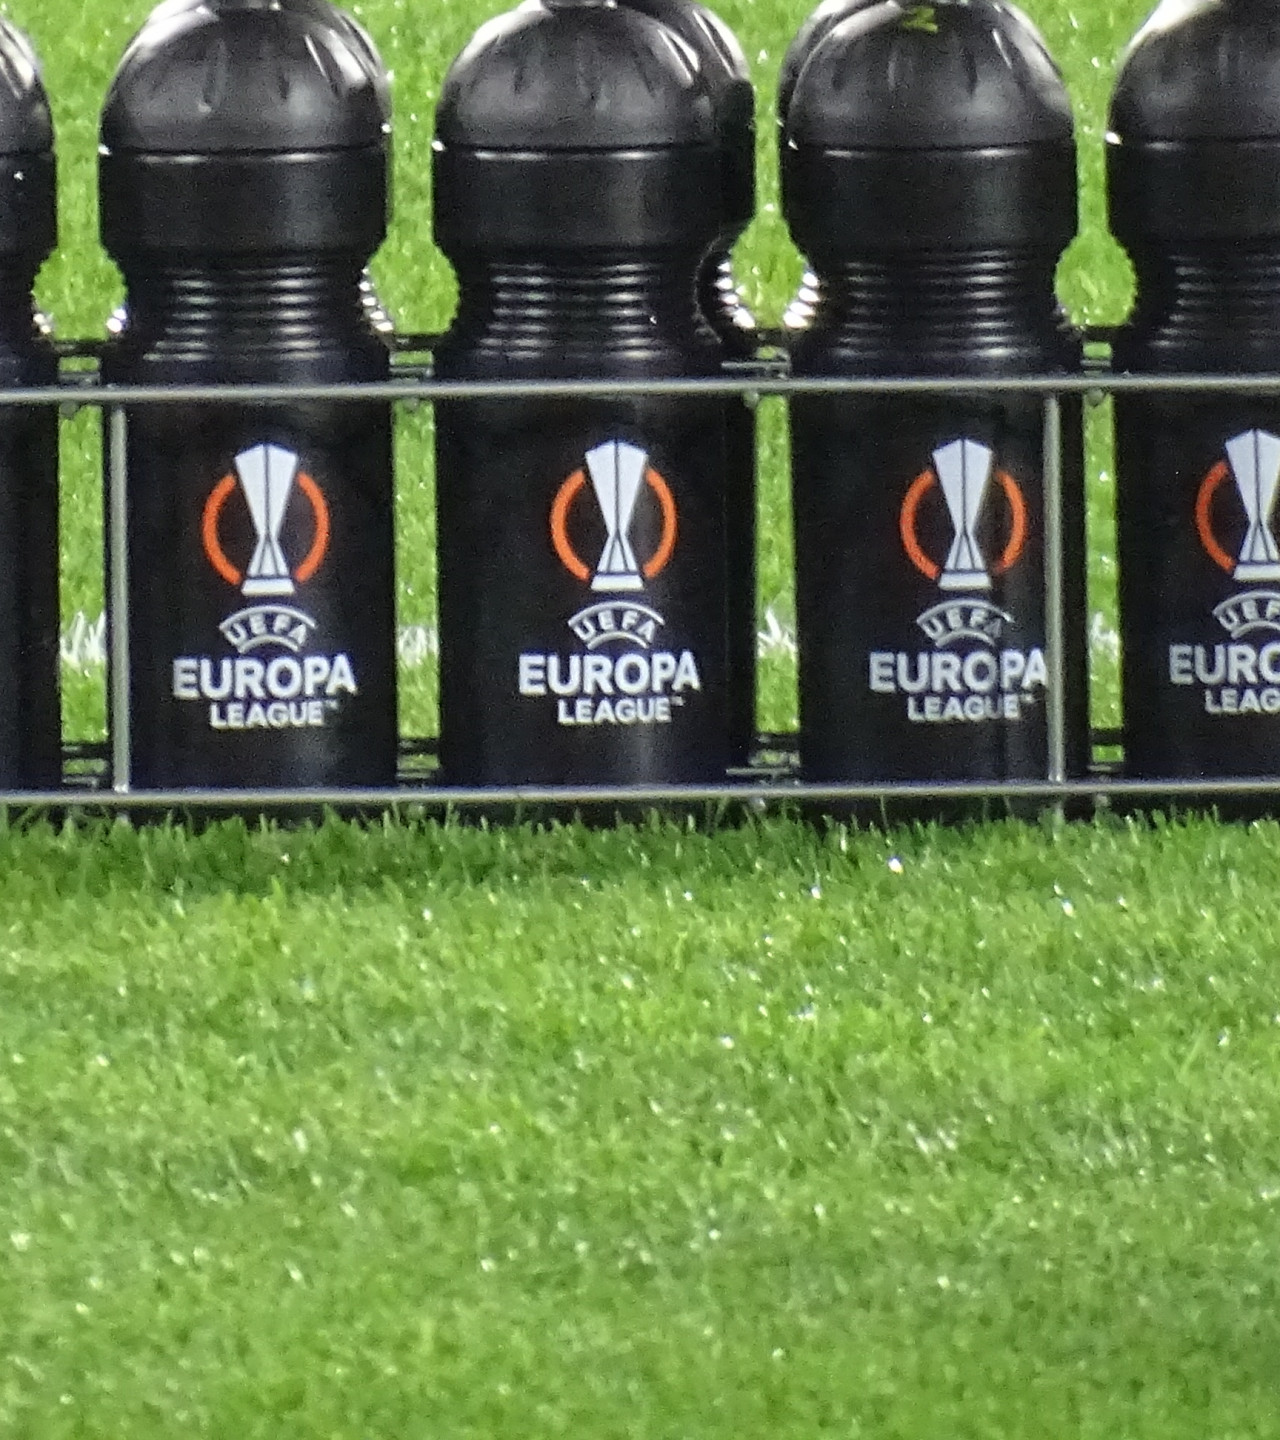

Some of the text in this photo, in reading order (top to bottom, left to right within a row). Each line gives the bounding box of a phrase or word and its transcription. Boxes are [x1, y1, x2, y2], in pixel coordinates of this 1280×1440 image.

[223, 614, 310, 646] UEFA
[572, 606, 655, 645] UEFA
[921, 606, 1004, 644] UEFA
[171, 655, 358, 701] EUROPA
[518, 650, 702, 696] EUROPA
[868, 648, 1048, 694] EUROPA
